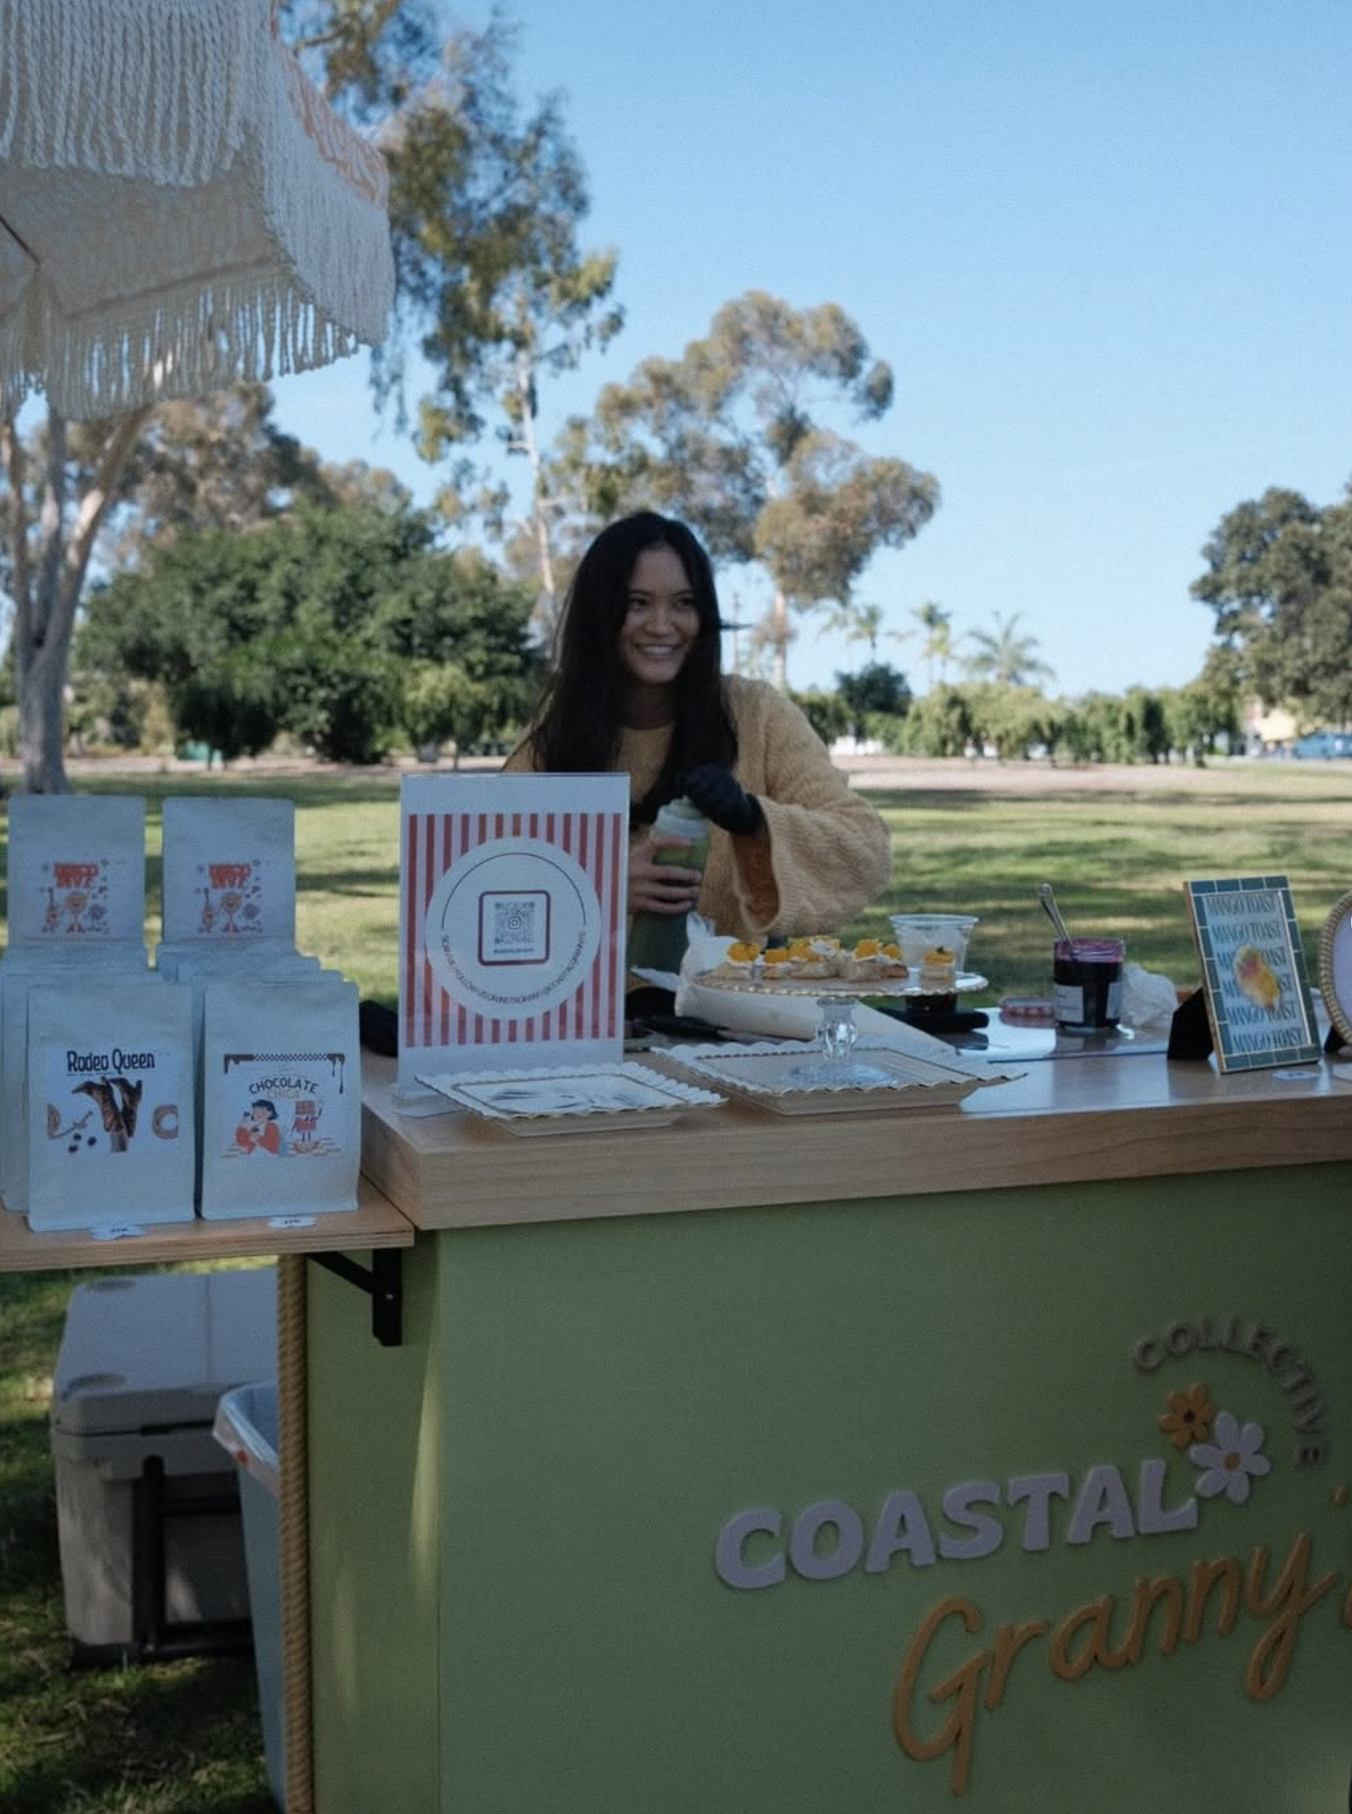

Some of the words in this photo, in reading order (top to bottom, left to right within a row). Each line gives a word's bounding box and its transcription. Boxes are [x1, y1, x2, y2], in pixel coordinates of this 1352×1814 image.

[1212, 924, 1250, 944] MANGO
[1250, 921, 1282, 941] TOAST
[67, 1050, 109, 1072] Rodeo
[112, 1048, 155, 1074] Queen
[249, 1077, 319, 1095] CHOCOLATE
[1134, 1316, 1326, 1465] COLLECTIVE
[715, 1458, 1199, 1591] COASTAL
